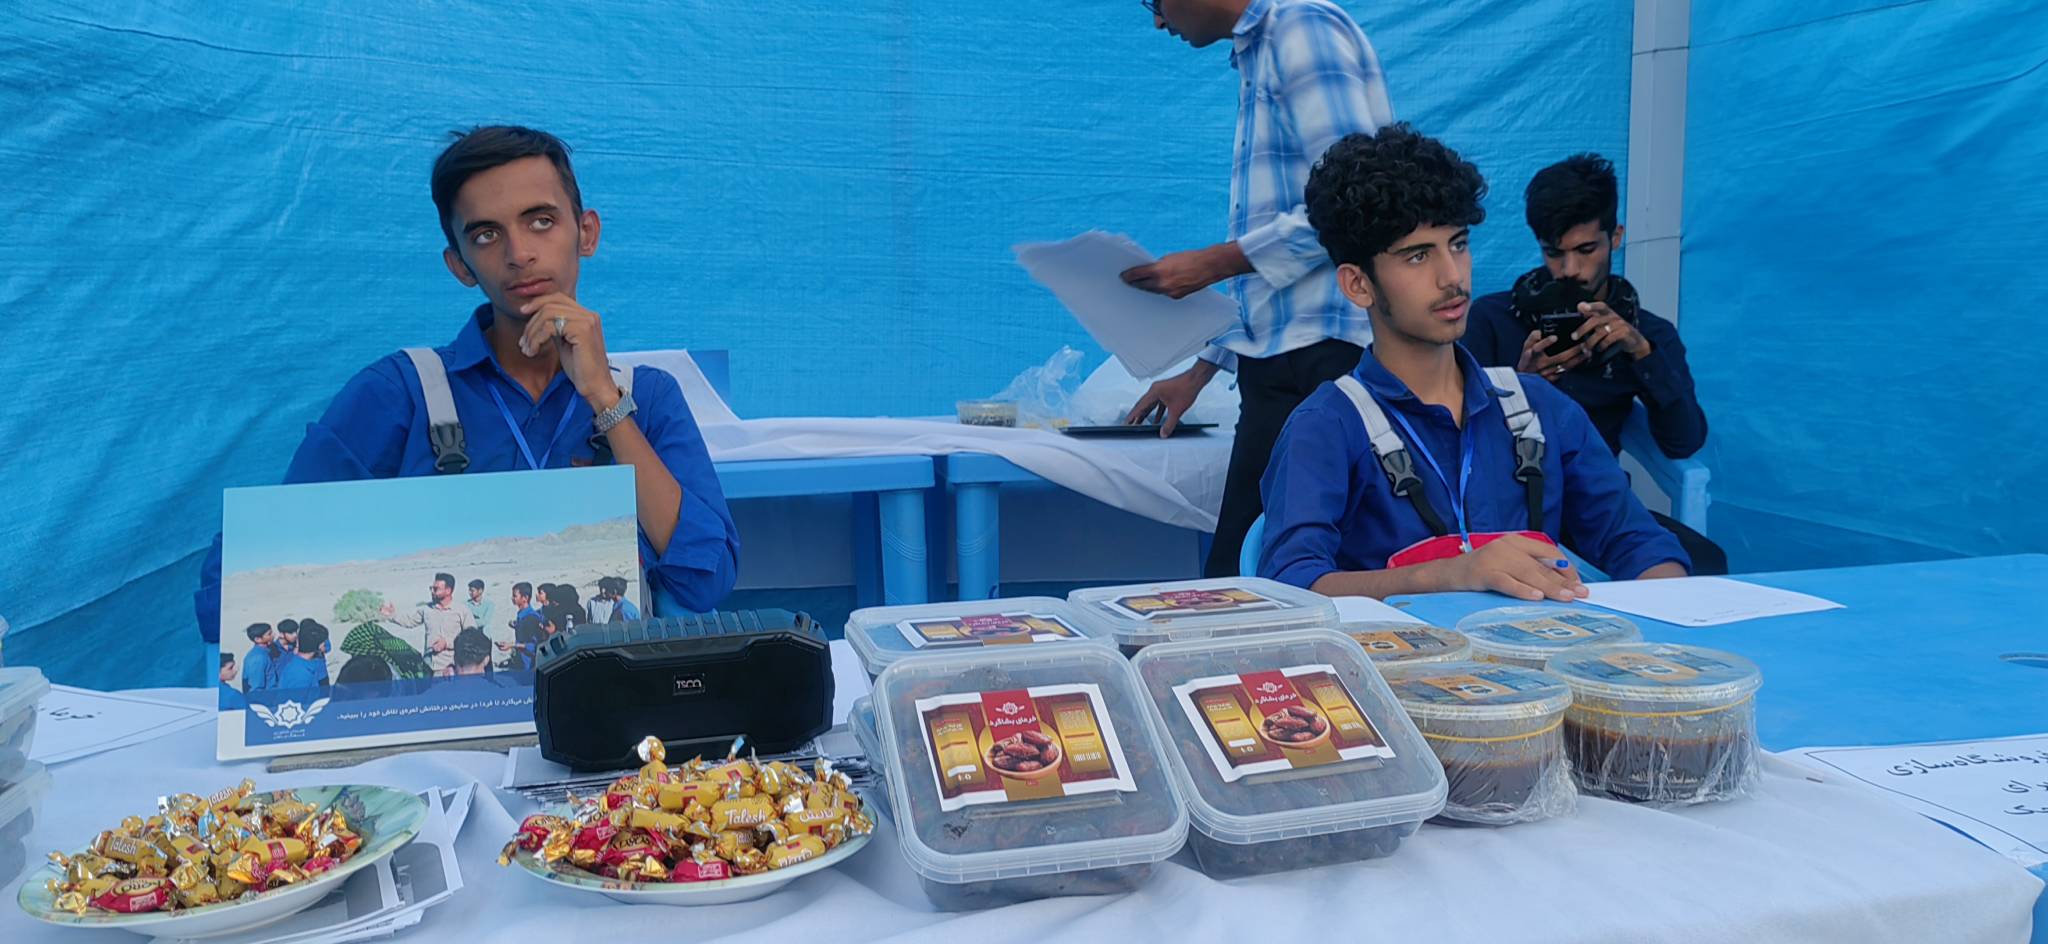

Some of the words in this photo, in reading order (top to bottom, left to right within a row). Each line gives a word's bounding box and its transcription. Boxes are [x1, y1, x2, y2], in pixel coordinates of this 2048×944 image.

[676, 678, 702, 689] TSCO
[479, 700, 493, 708] فردا
[368, 710, 381, 718] خود
[1015, 715, 1037, 725] خرمای
[725, 808, 766, 824] Talesh
[111, 835, 138, 856] Talesh
